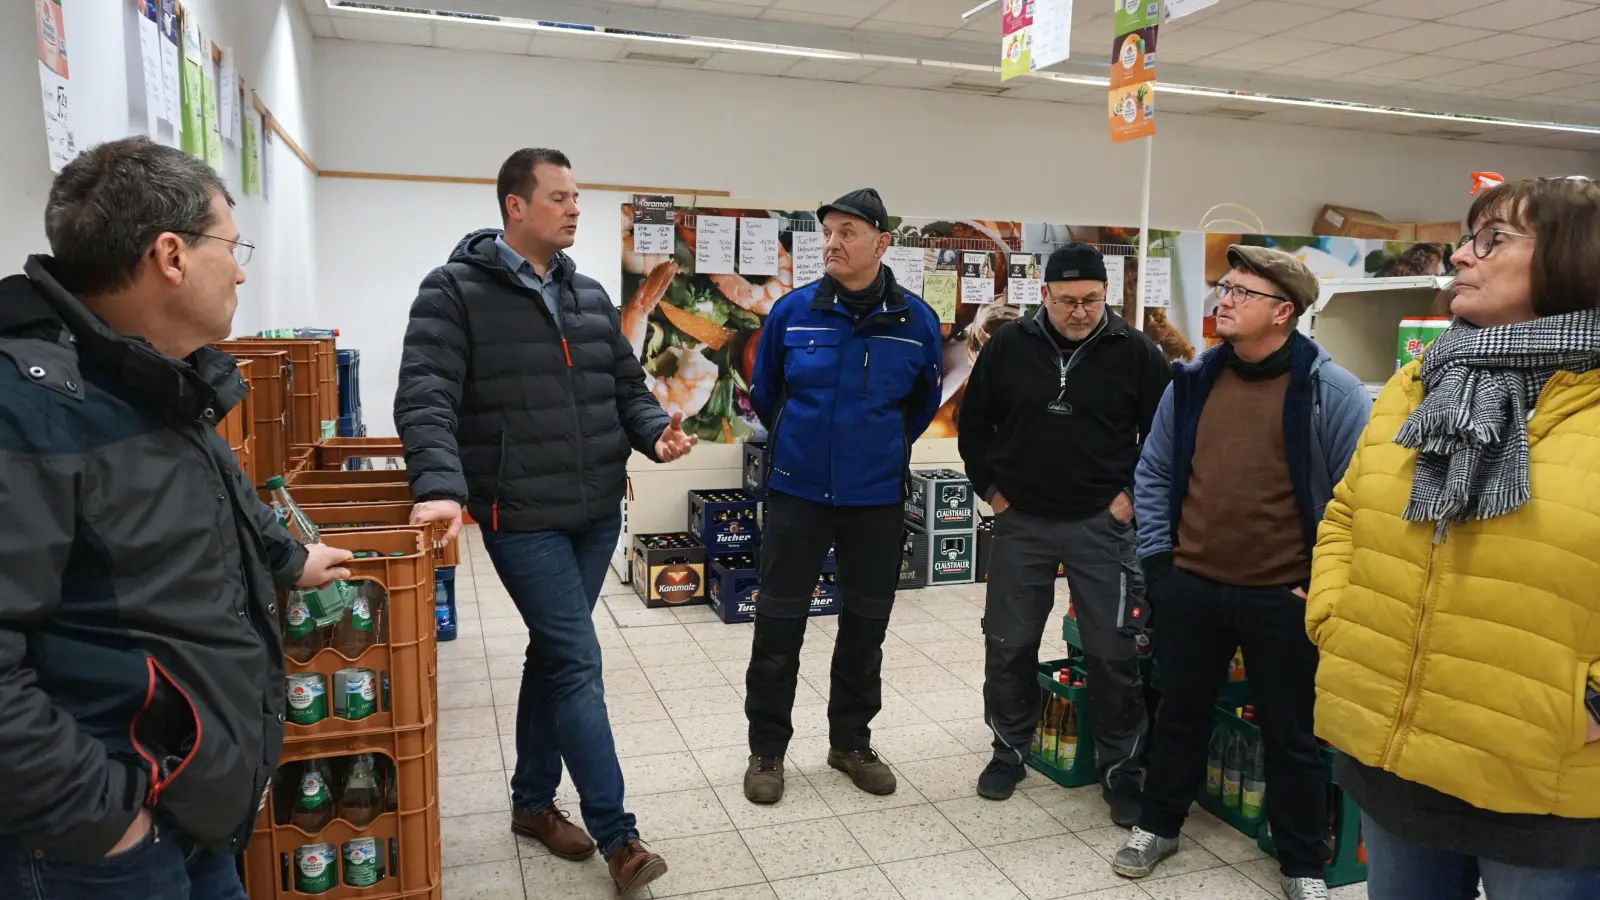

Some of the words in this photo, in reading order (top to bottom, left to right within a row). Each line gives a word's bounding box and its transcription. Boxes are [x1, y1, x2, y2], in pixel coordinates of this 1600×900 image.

[639, 199, 673, 208] Karamalz
[936, 509, 971, 519] CLAUSTHALER
[716, 533, 751, 542] Tucher
[934, 561, 970, 571] CLAUSTHALER
[659, 584, 696, 593] Karamalz
[737, 602, 756, 612] Tuc
